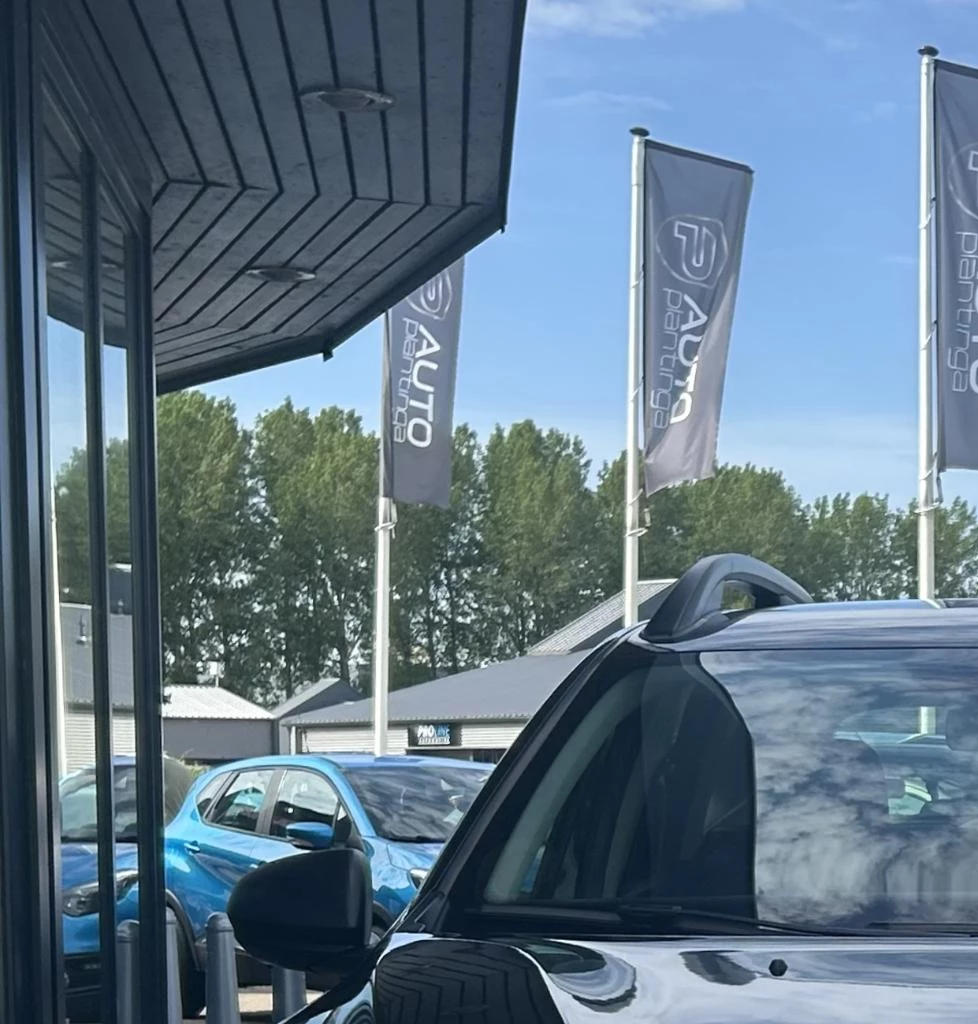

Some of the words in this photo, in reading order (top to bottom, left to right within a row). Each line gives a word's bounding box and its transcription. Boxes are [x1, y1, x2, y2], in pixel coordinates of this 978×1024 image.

[392, 318, 419, 443] plantinga
[407, 324, 441, 448] AUTO
[650, 287, 683, 430] plantinga
